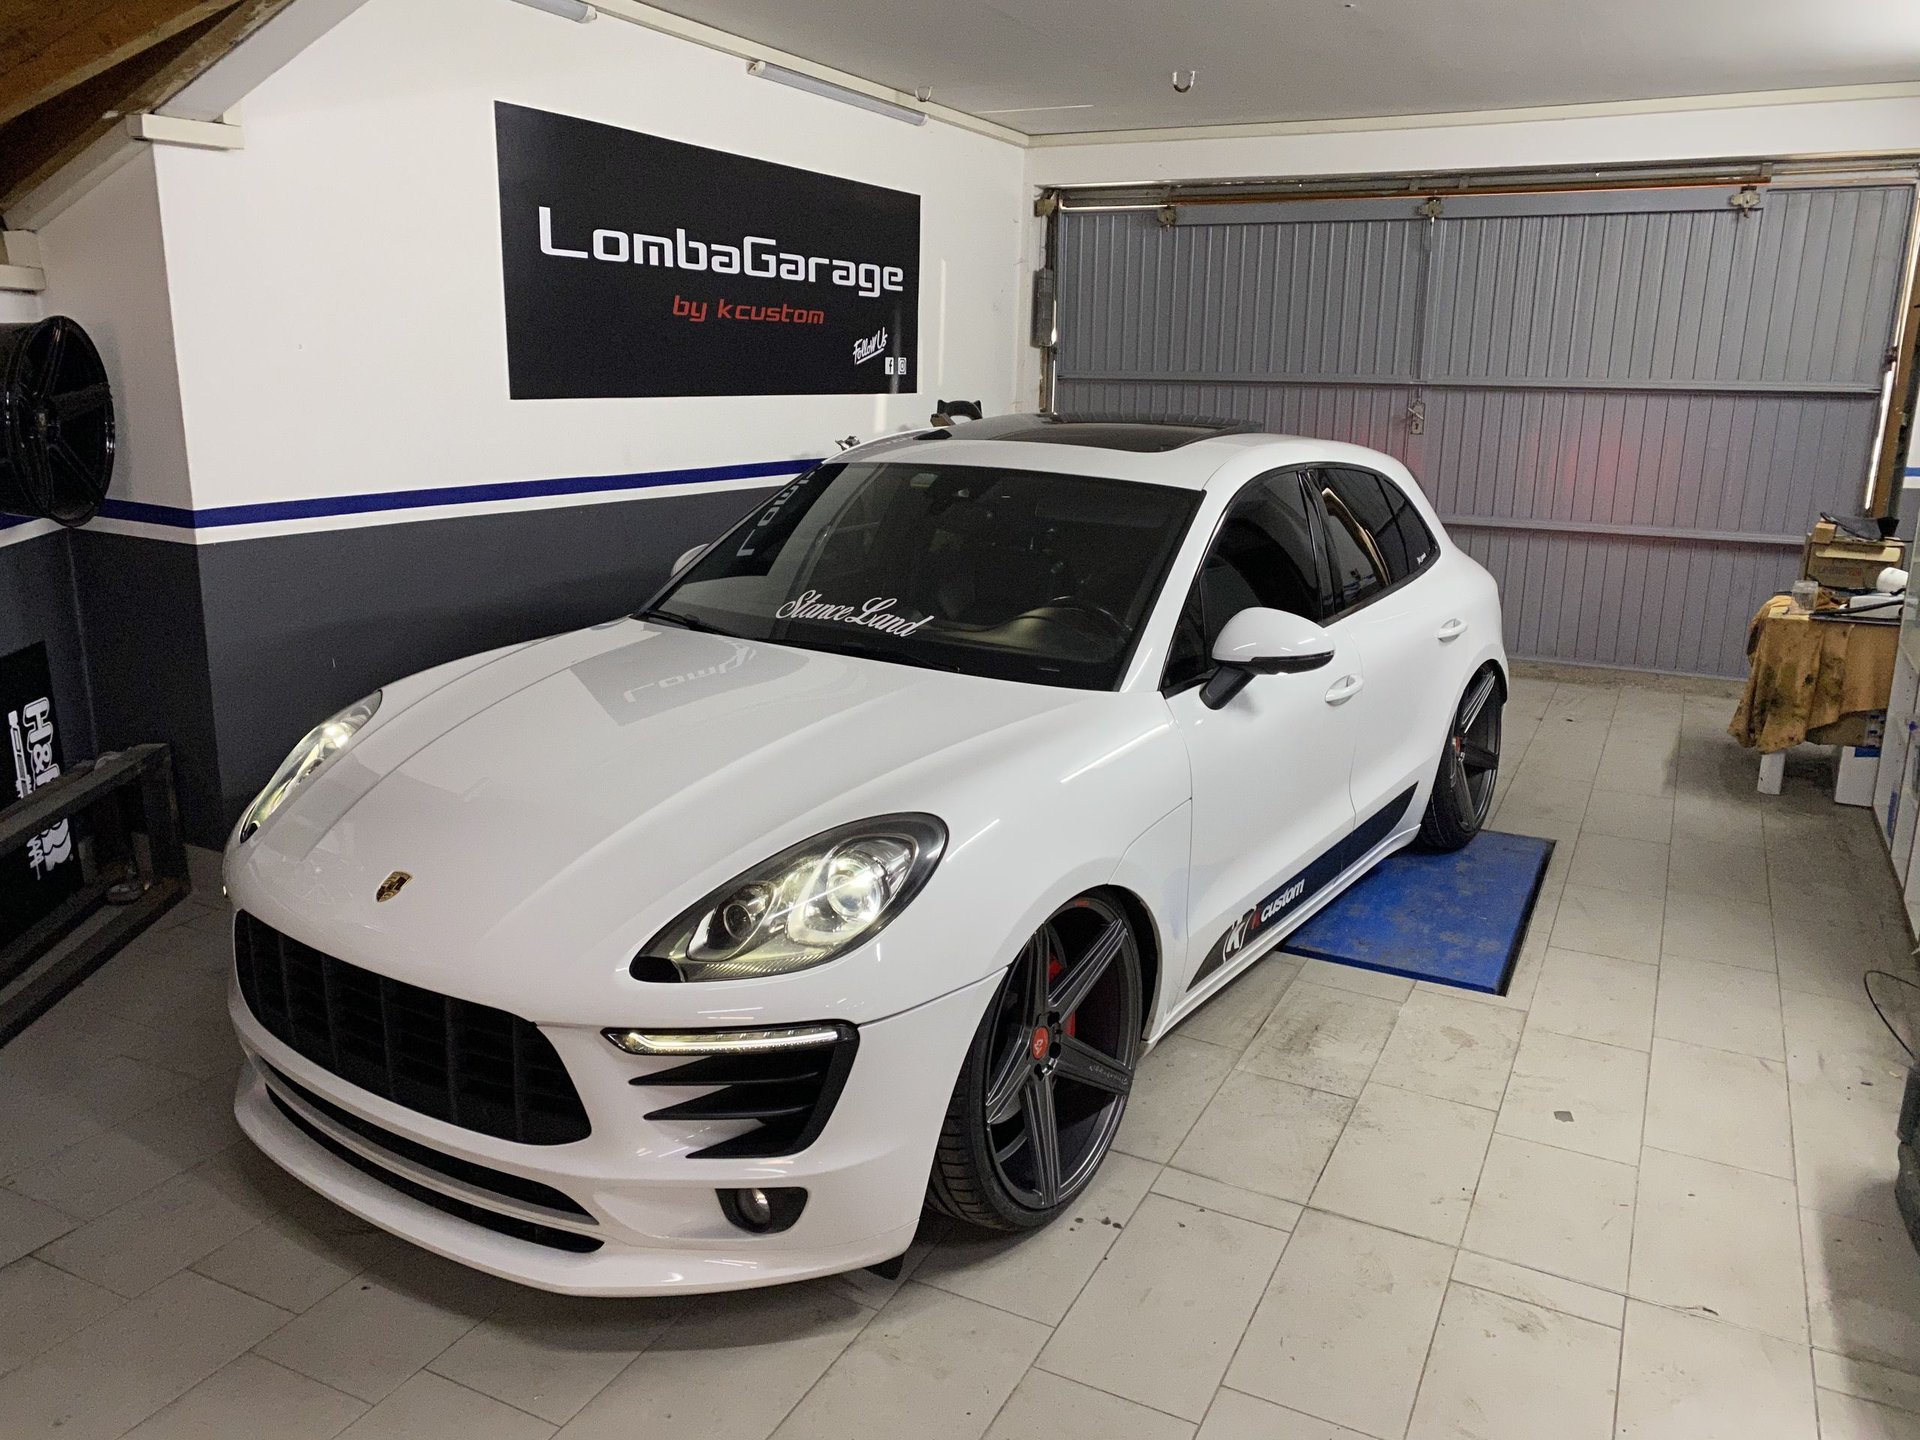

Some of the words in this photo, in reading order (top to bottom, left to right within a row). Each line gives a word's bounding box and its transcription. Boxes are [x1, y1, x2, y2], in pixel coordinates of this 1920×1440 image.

[538, 206, 904, 298] LombaGarage
[672, 294, 708, 323] by
[717, 298, 825, 325] kcustom
